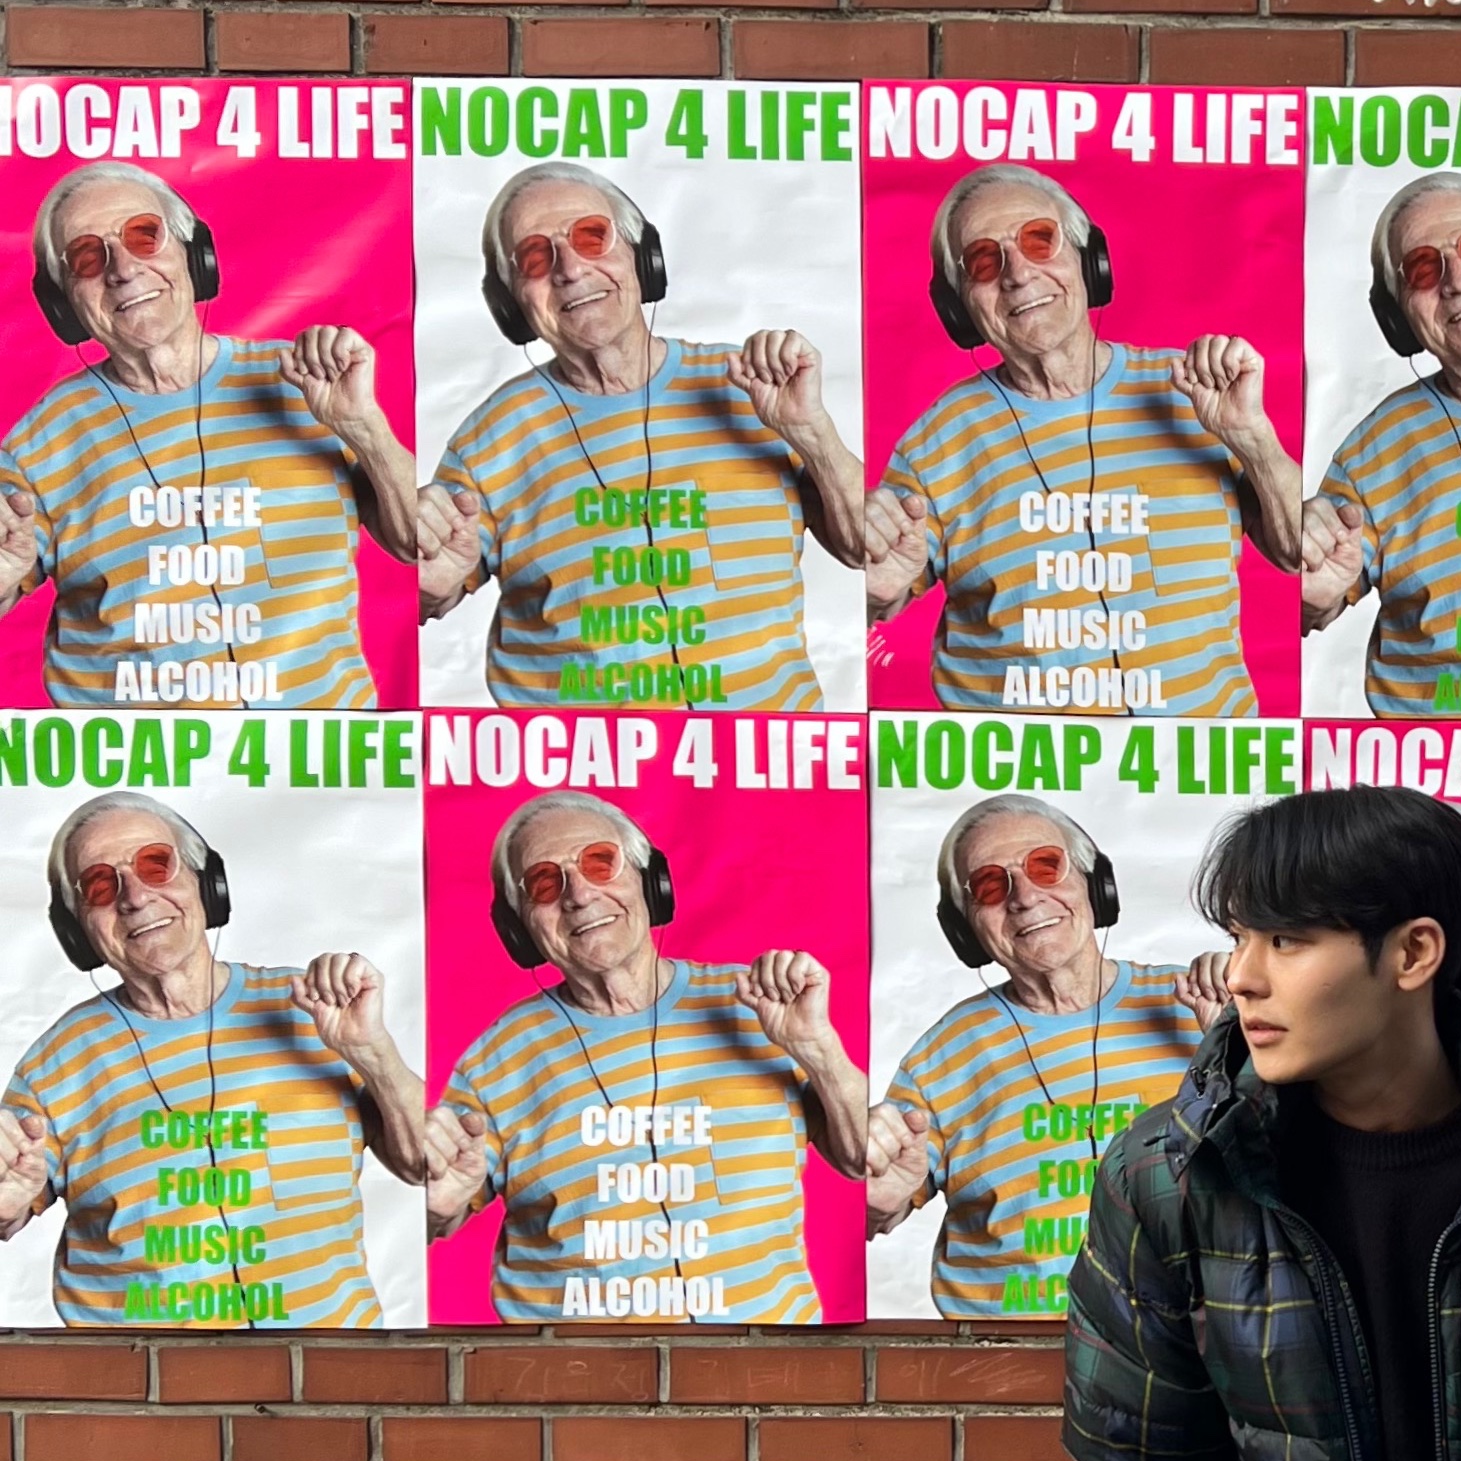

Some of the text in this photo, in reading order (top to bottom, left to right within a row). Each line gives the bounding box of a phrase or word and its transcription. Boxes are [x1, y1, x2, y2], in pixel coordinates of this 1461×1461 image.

[217, 86, 261, 158] 4
[278, 87, 406, 159] LIFE
[421, 87, 852, 161] NOCAP 4 LIFE
[869, 86, 1298, 165] NOCAP 4 LIFE
[127, 485, 262, 527] COFFEE
[575, 487, 706, 529] COFFEE
[1018, 490, 1149, 532] COFFEE
[147, 544, 244, 585] FOOD
[592, 545, 691, 586] FOOD
[1035, 550, 1131, 592] FOOD
[133, 602, 262, 644] MUSIC
[580, 605, 706, 644] MUSIC
[1022, 608, 1146, 650] MUSIC
[113, 660, 282, 701] ALCOHOL
[558, 661, 728, 704] ALCOHOL
[1002, 666, 1166, 708] ALCOHOL
[229, 720, 270, 787] 4
[290, 720, 414, 788] LIFE
[430, 715, 860, 789] NOCAP 4 LIFE
[878, 720, 1295, 795] NOCAP 4 LIFE
[140, 1109, 268, 1150] COFFEE
[580, 1104, 711, 1146] COFFEE
[1023, 1103, 1150, 1142] COFFE
[158, 1167, 252, 1207] FOOD
[596, 1162, 694, 1203] FOOD
[144, 1224, 266, 1266] MUSIC
[583, 1219, 707, 1259] MUSIC
[123, 1281, 289, 1322] ALCOHOL
[562, 1276, 728, 1317] ALCOHOL
